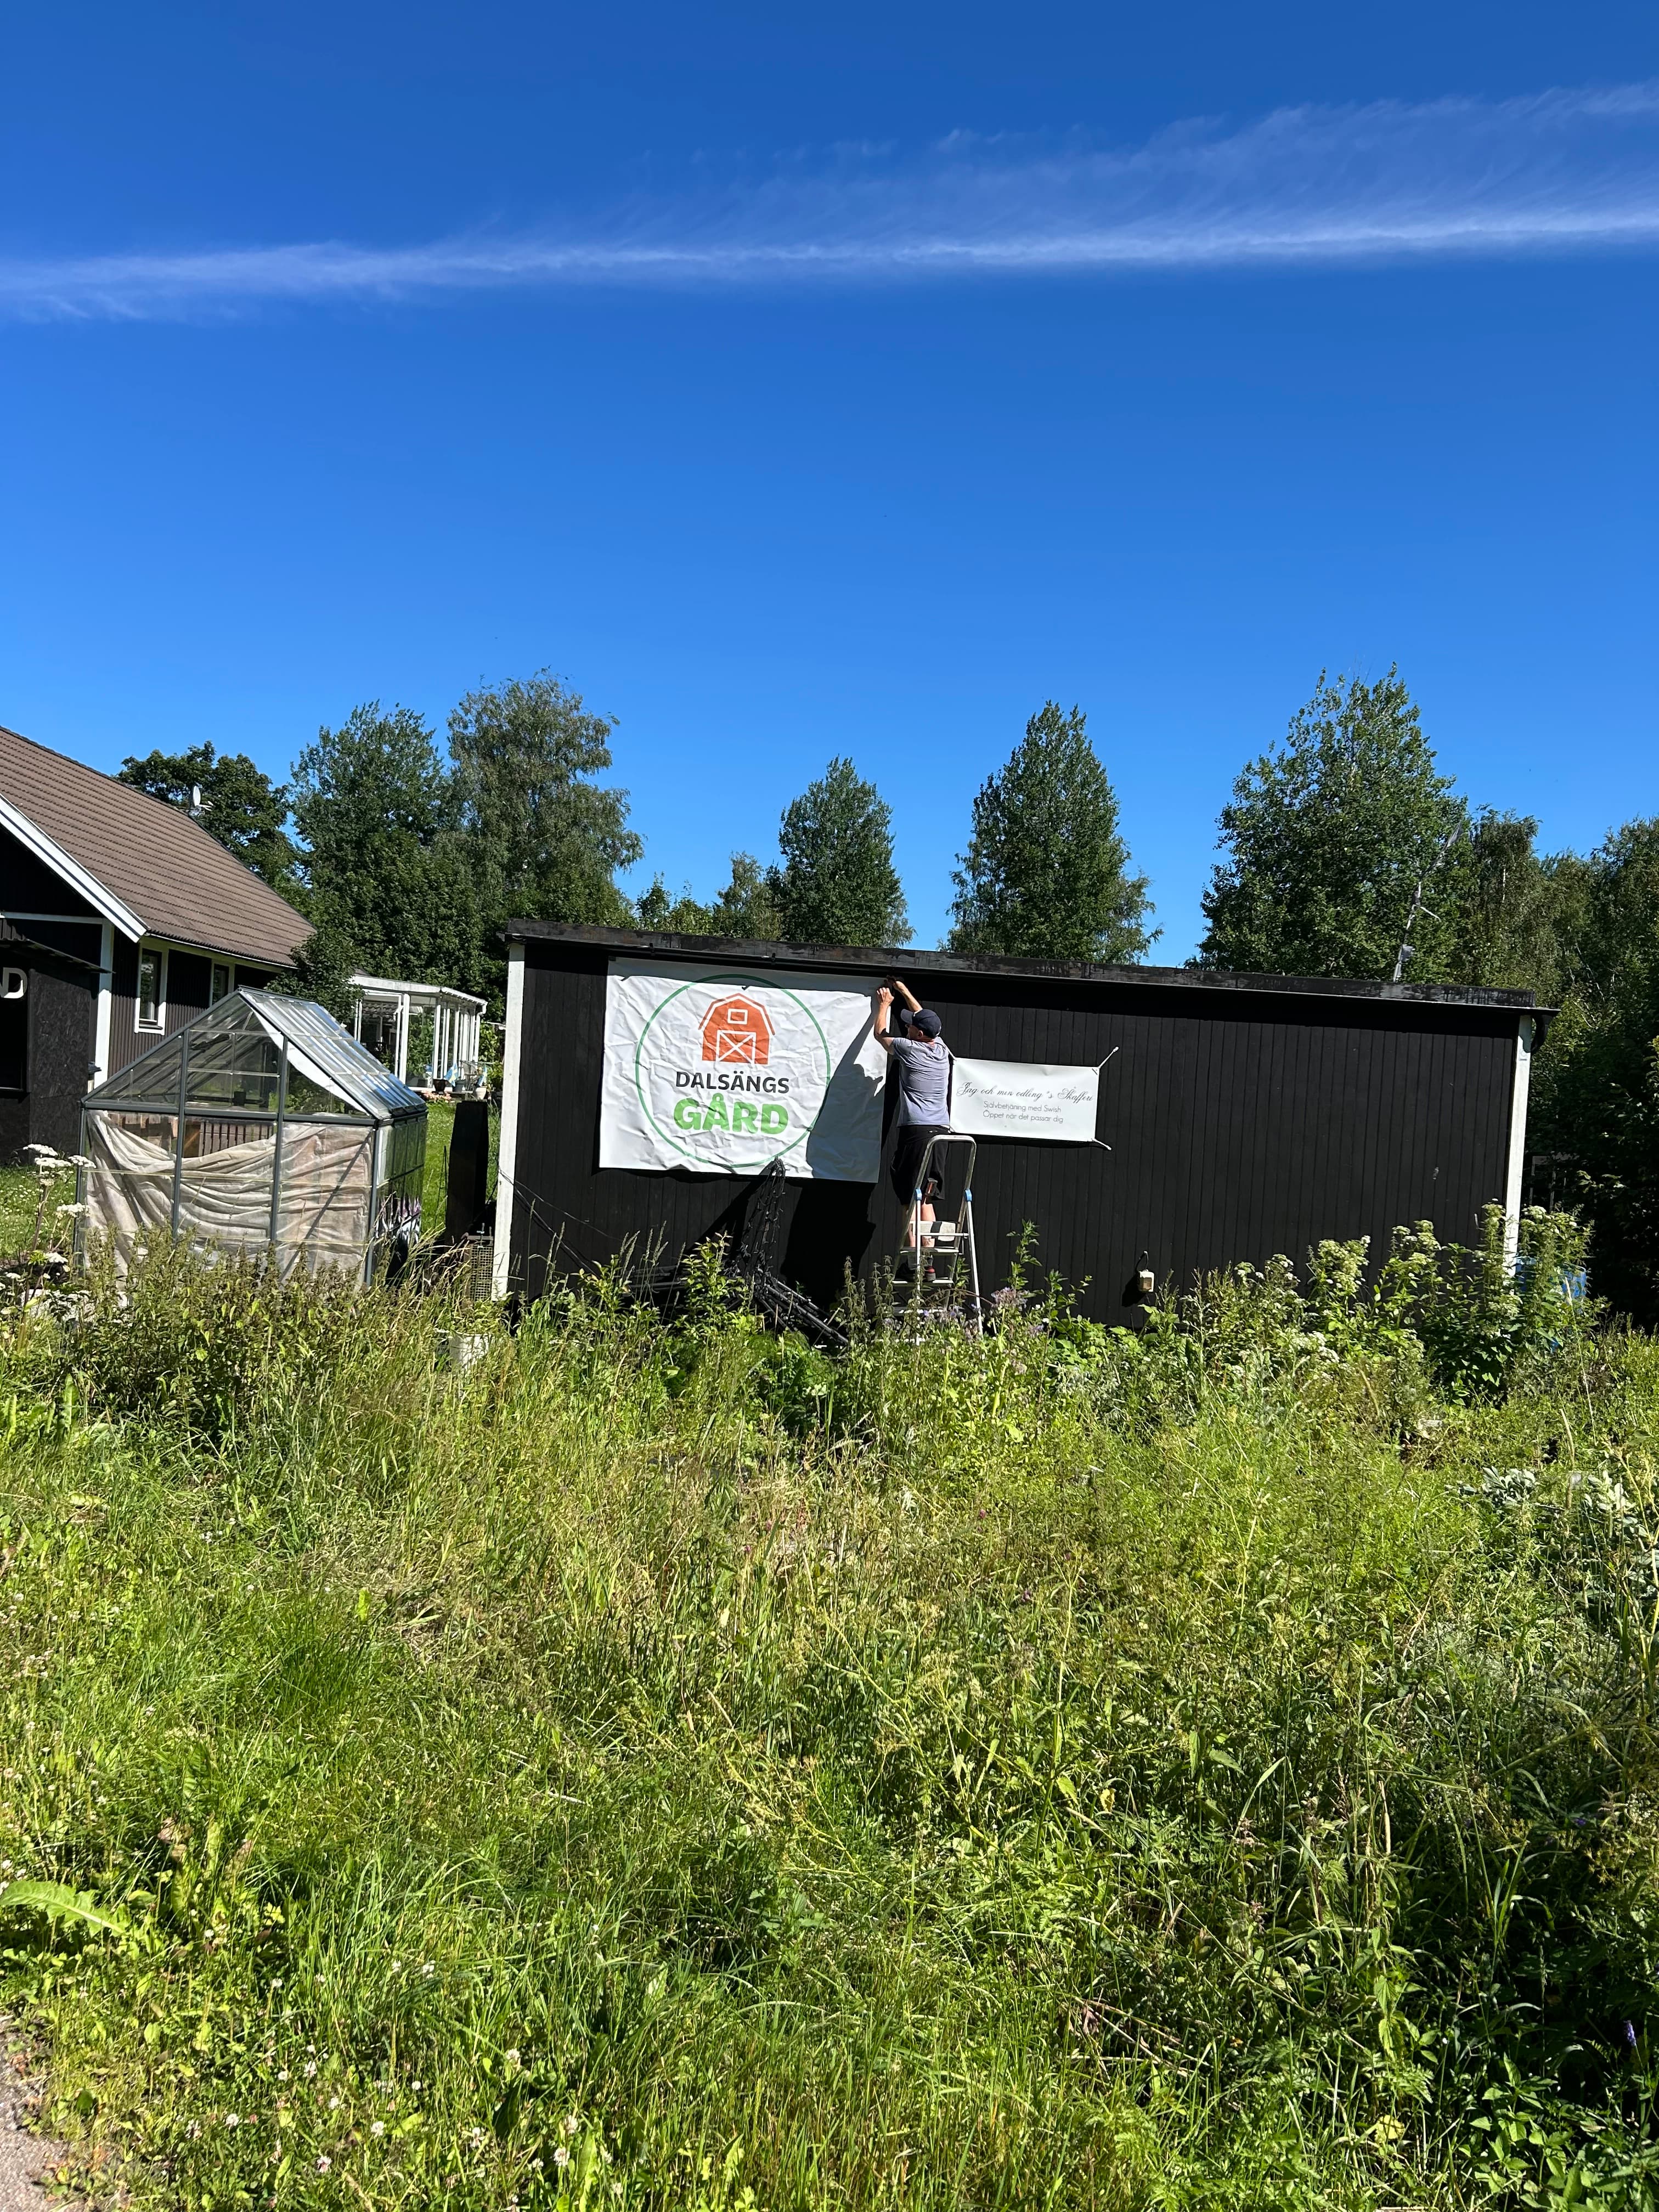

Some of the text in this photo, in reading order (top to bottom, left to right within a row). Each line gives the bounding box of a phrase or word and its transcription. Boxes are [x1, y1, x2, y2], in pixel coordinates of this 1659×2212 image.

[676, 1070, 789, 1094] DALSÄNGS
[956, 1081, 979, 1097] Jag
[980, 1086, 997, 1095] och
[1016, 1087, 1043, 1102] odling
[674, 1092, 789, 1135] GÅRD
[983, 1101, 1026, 1111] Självbetjäning
[1044, 1104, 1061, 1113] Swish
[983, 1109, 1004, 1119] Öppet
[1053, 1114, 1063, 1124] dig
